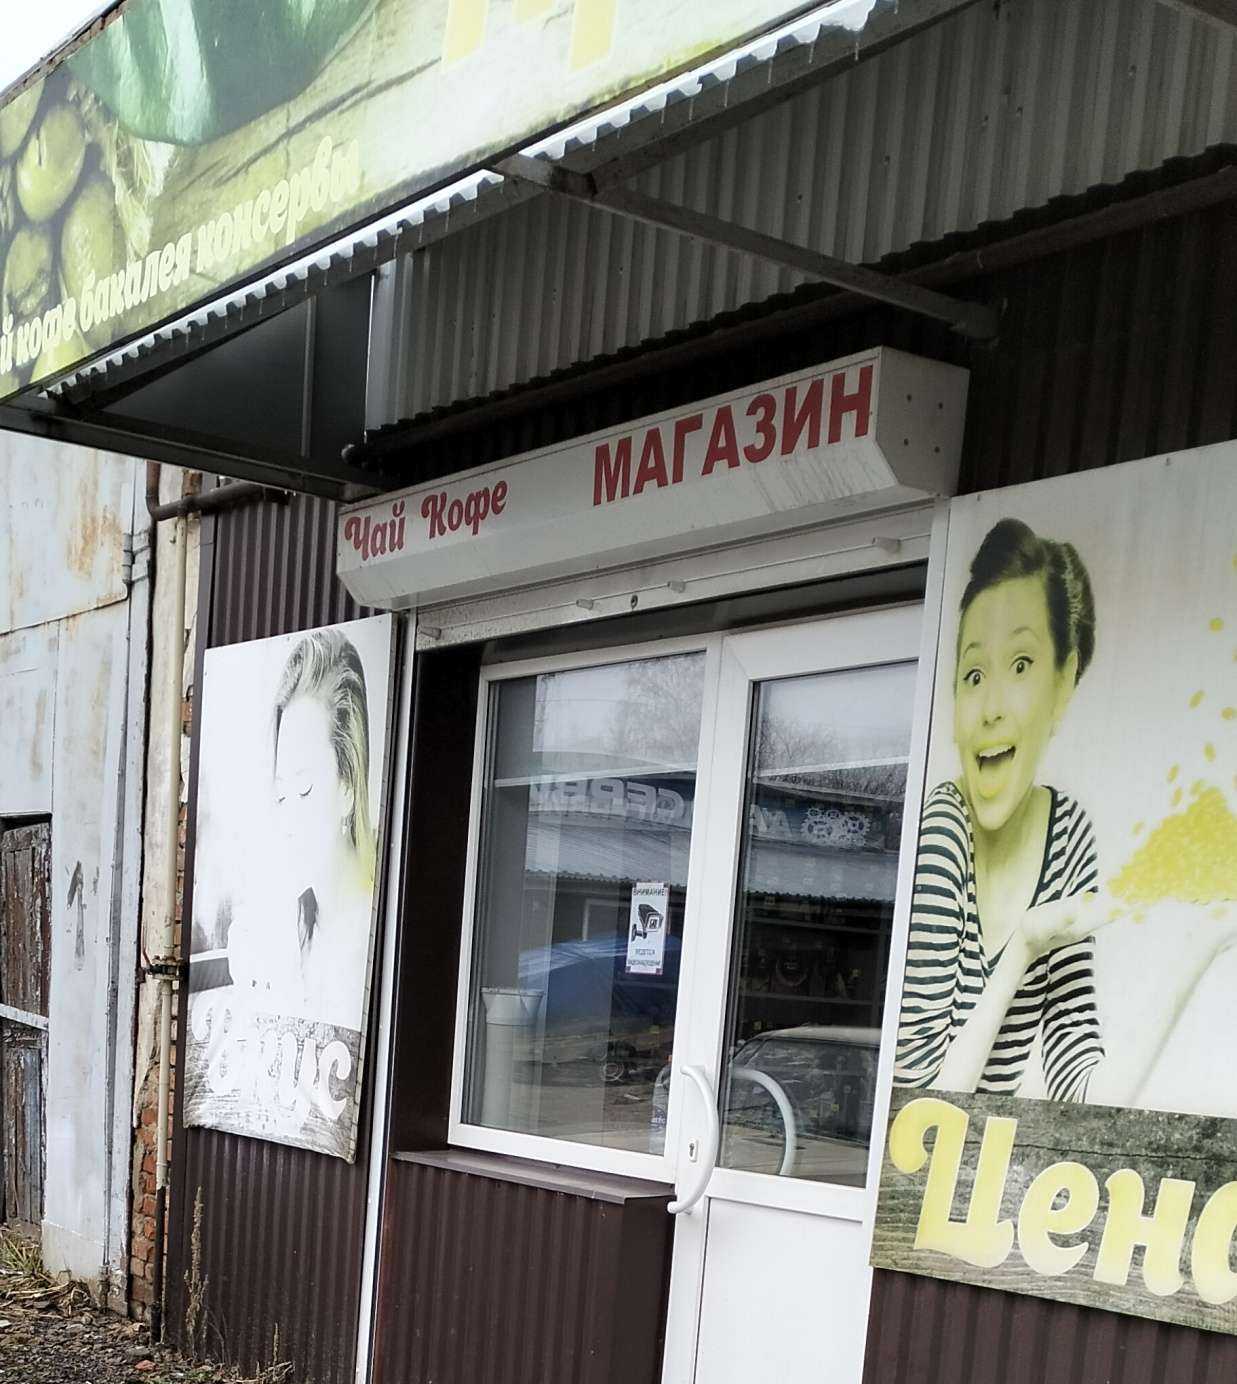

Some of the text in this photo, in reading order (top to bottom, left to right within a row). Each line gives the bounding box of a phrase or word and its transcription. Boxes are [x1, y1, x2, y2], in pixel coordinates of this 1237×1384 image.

[15, 297, 77, 366] кофе
[79, 231, 193, 332] бакалея
[196, 135, 360, 274] консервы
[592, 366, 874, 507] МАГАЗИН
[345, 479, 508, 562] Чай Кофе
